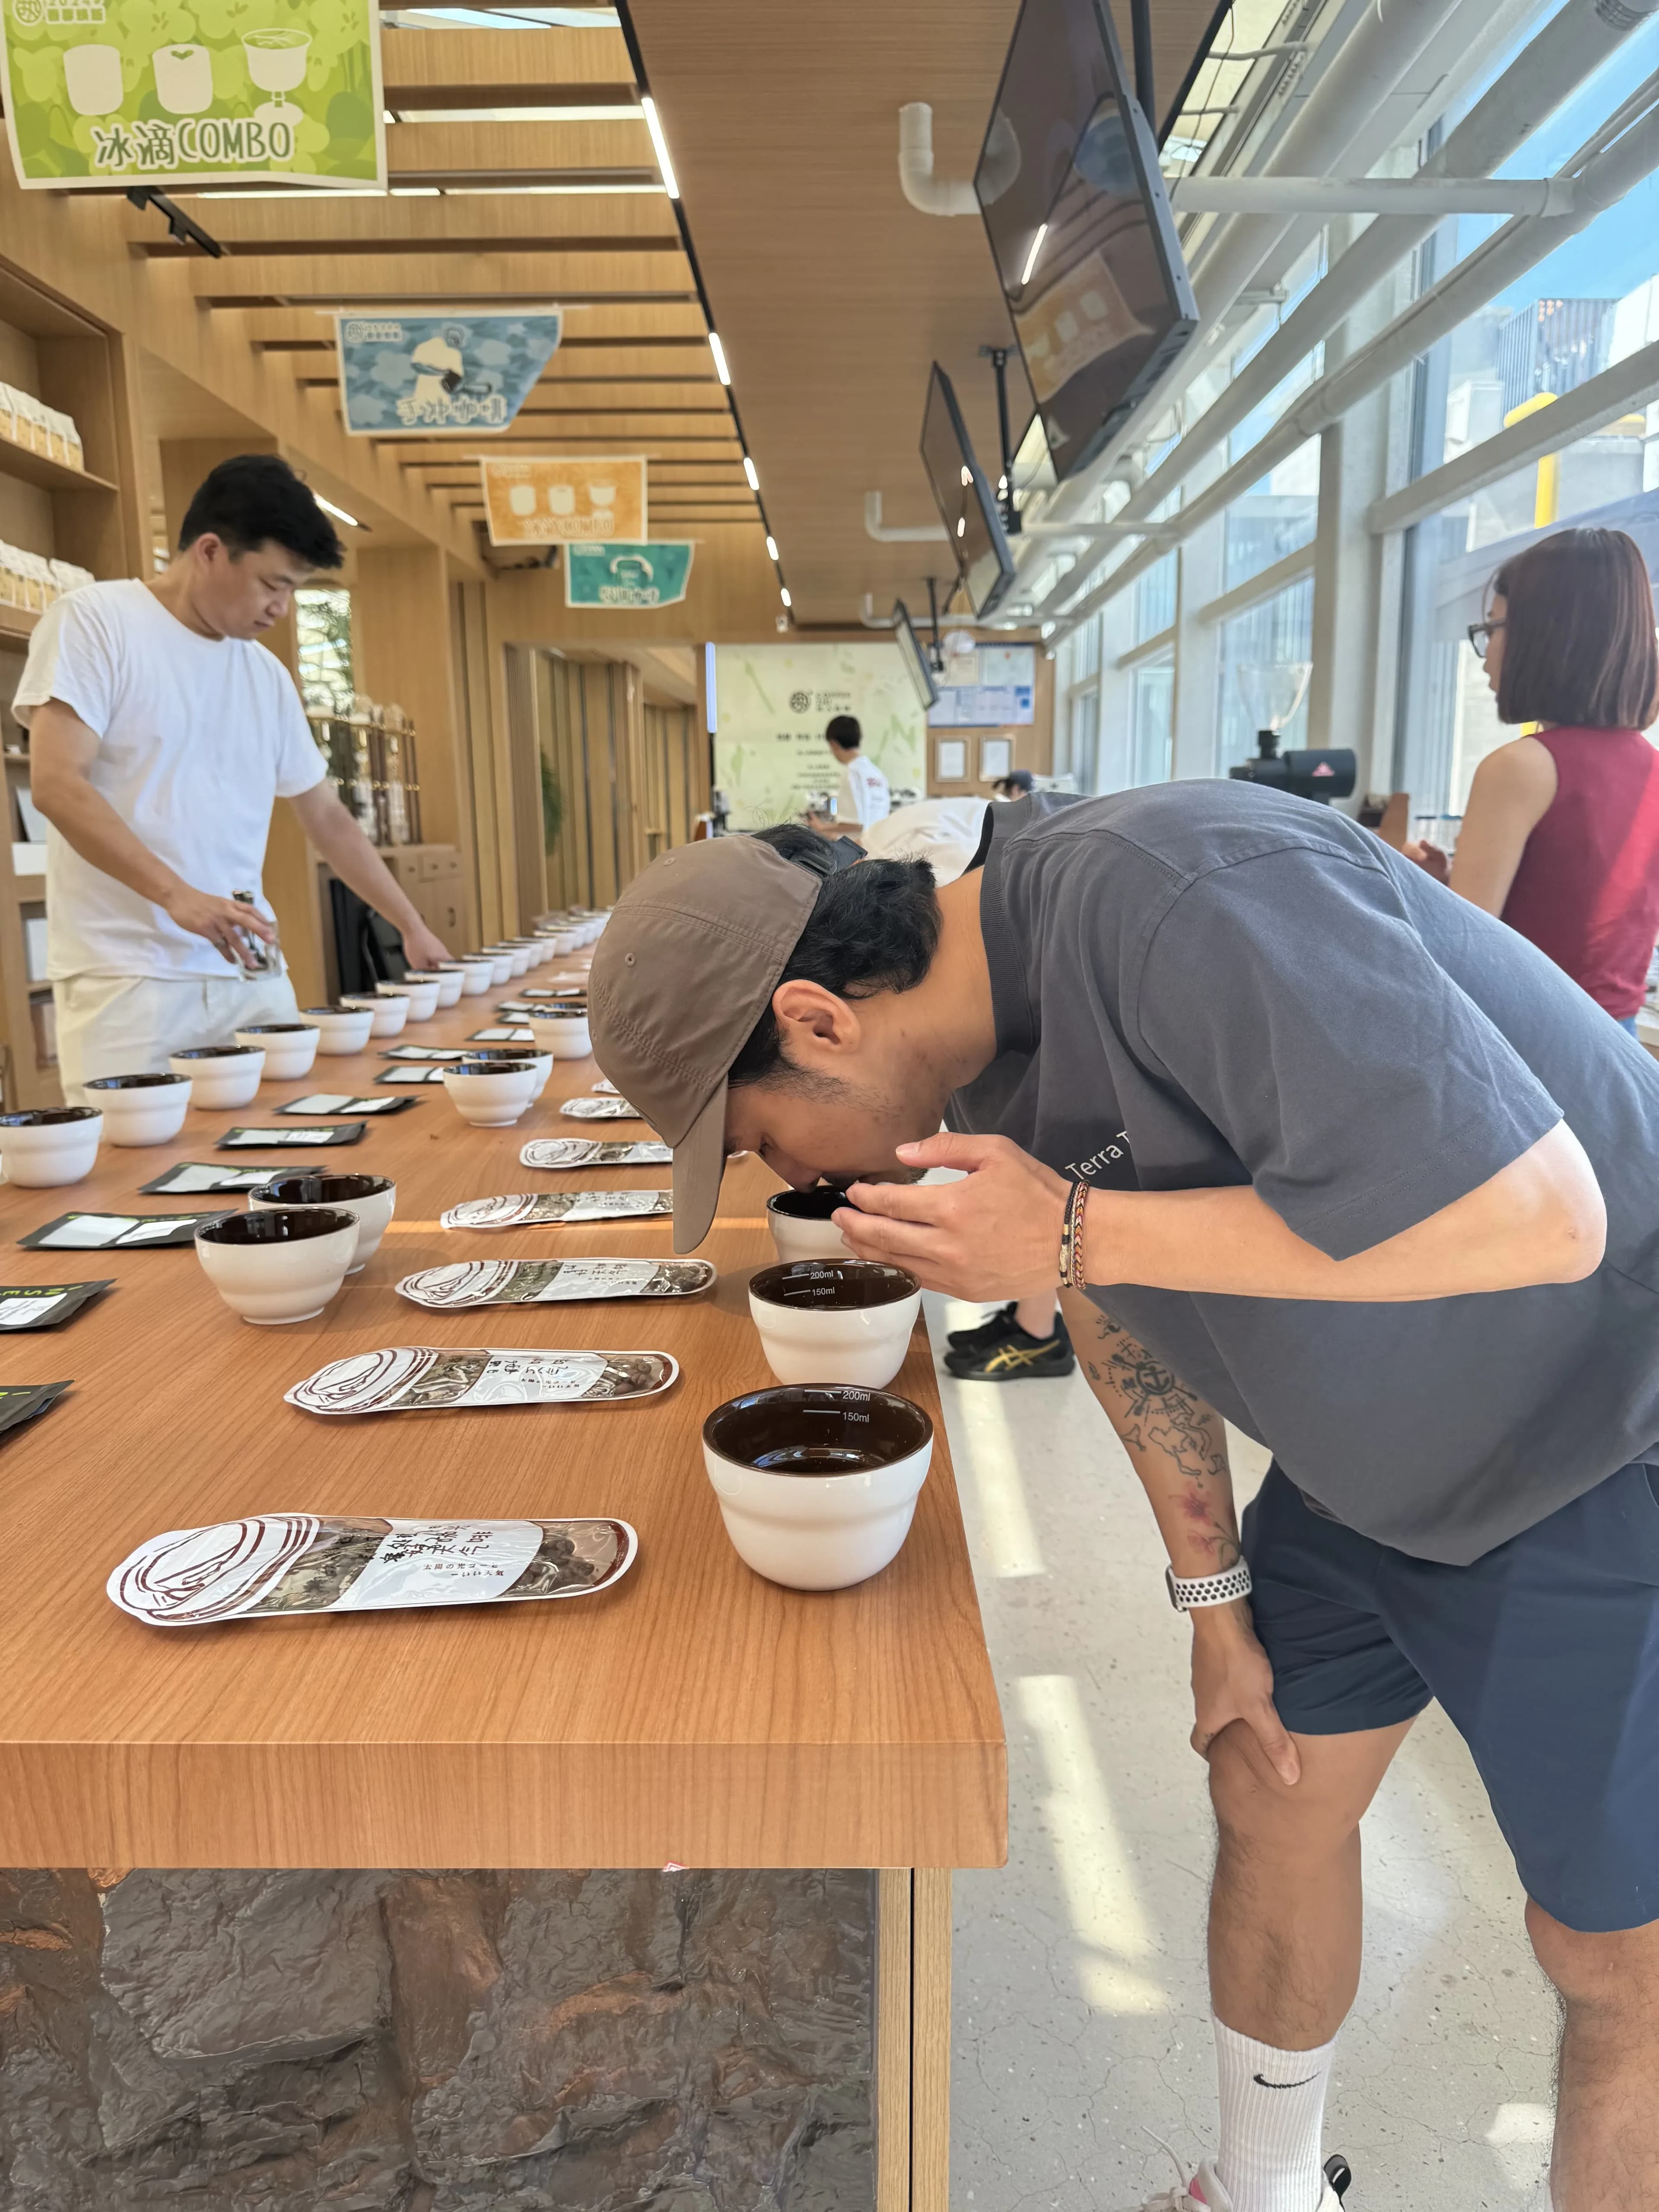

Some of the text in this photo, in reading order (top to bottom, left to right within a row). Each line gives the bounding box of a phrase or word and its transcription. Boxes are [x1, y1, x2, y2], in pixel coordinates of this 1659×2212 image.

[1065, 1145, 1124, 1179] Terra
[810, 1270, 833, 1280] 200ml
[812, 1287, 835, 1296] 150ml
[843, 1390, 871, 1402] 200ml
[843, 1412, 869, 1423] 150ml
